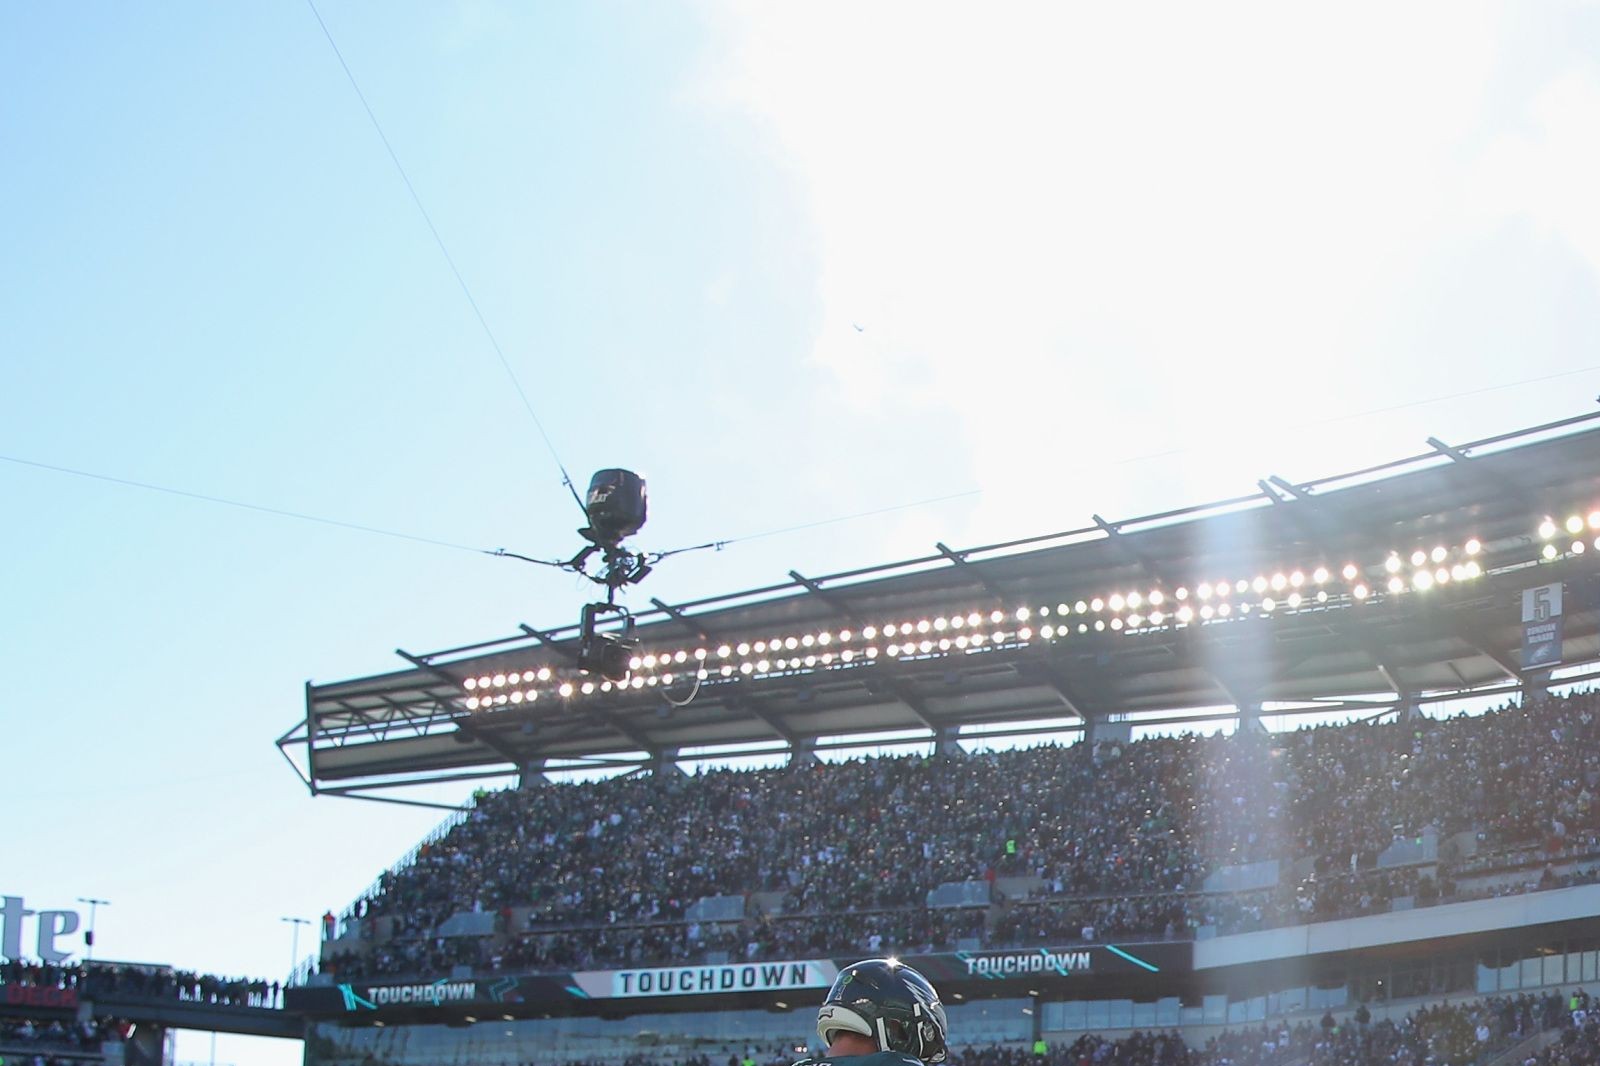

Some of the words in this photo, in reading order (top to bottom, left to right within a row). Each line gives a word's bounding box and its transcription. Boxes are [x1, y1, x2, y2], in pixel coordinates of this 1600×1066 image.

[1534, 587, 1551, 622] 5
[965, 952, 1091, 975] TOUCHDOWN
[620, 963, 807, 994] TOUCHDOWN
[368, 982, 476, 1004] TOUCHDOWN
